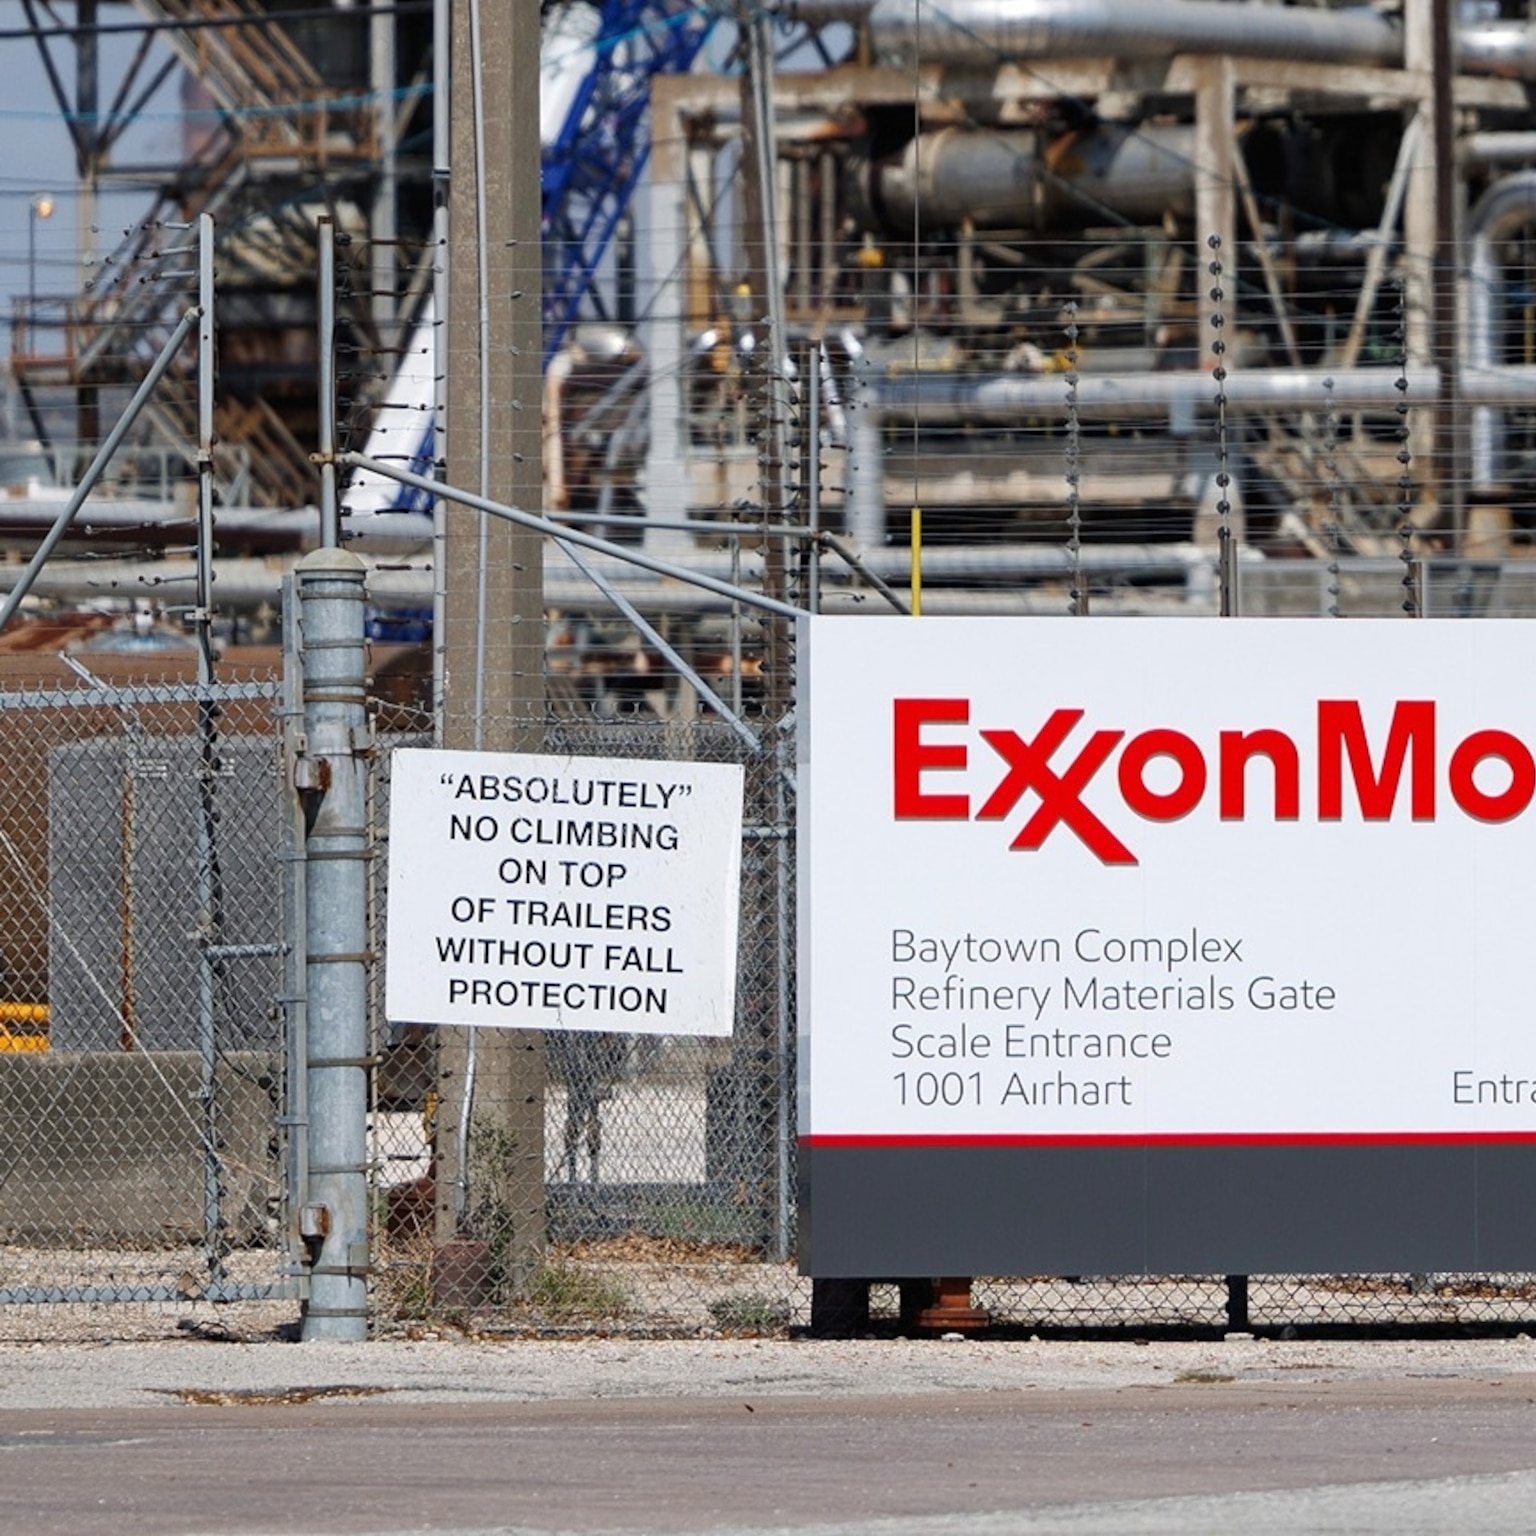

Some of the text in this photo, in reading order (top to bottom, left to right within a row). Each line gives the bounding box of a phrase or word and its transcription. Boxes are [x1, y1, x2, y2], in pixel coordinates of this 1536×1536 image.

[450, 814, 679, 850] NO CLIMBING
[499, 858, 627, 888] ON TOP
[451, 896, 671, 931] OF TRAILERS
[435, 937, 684, 973] WITHOUT FALL
[892, 929, 1242, 972] Baytown Complex
[449, 978, 667, 1014] PROTECTION
[892, 975, 1336, 1019] Refinery Materials Gate
[892, 1024, 1172, 1058] Scale Entrance
[894, 1072, 981, 1106] 1001
